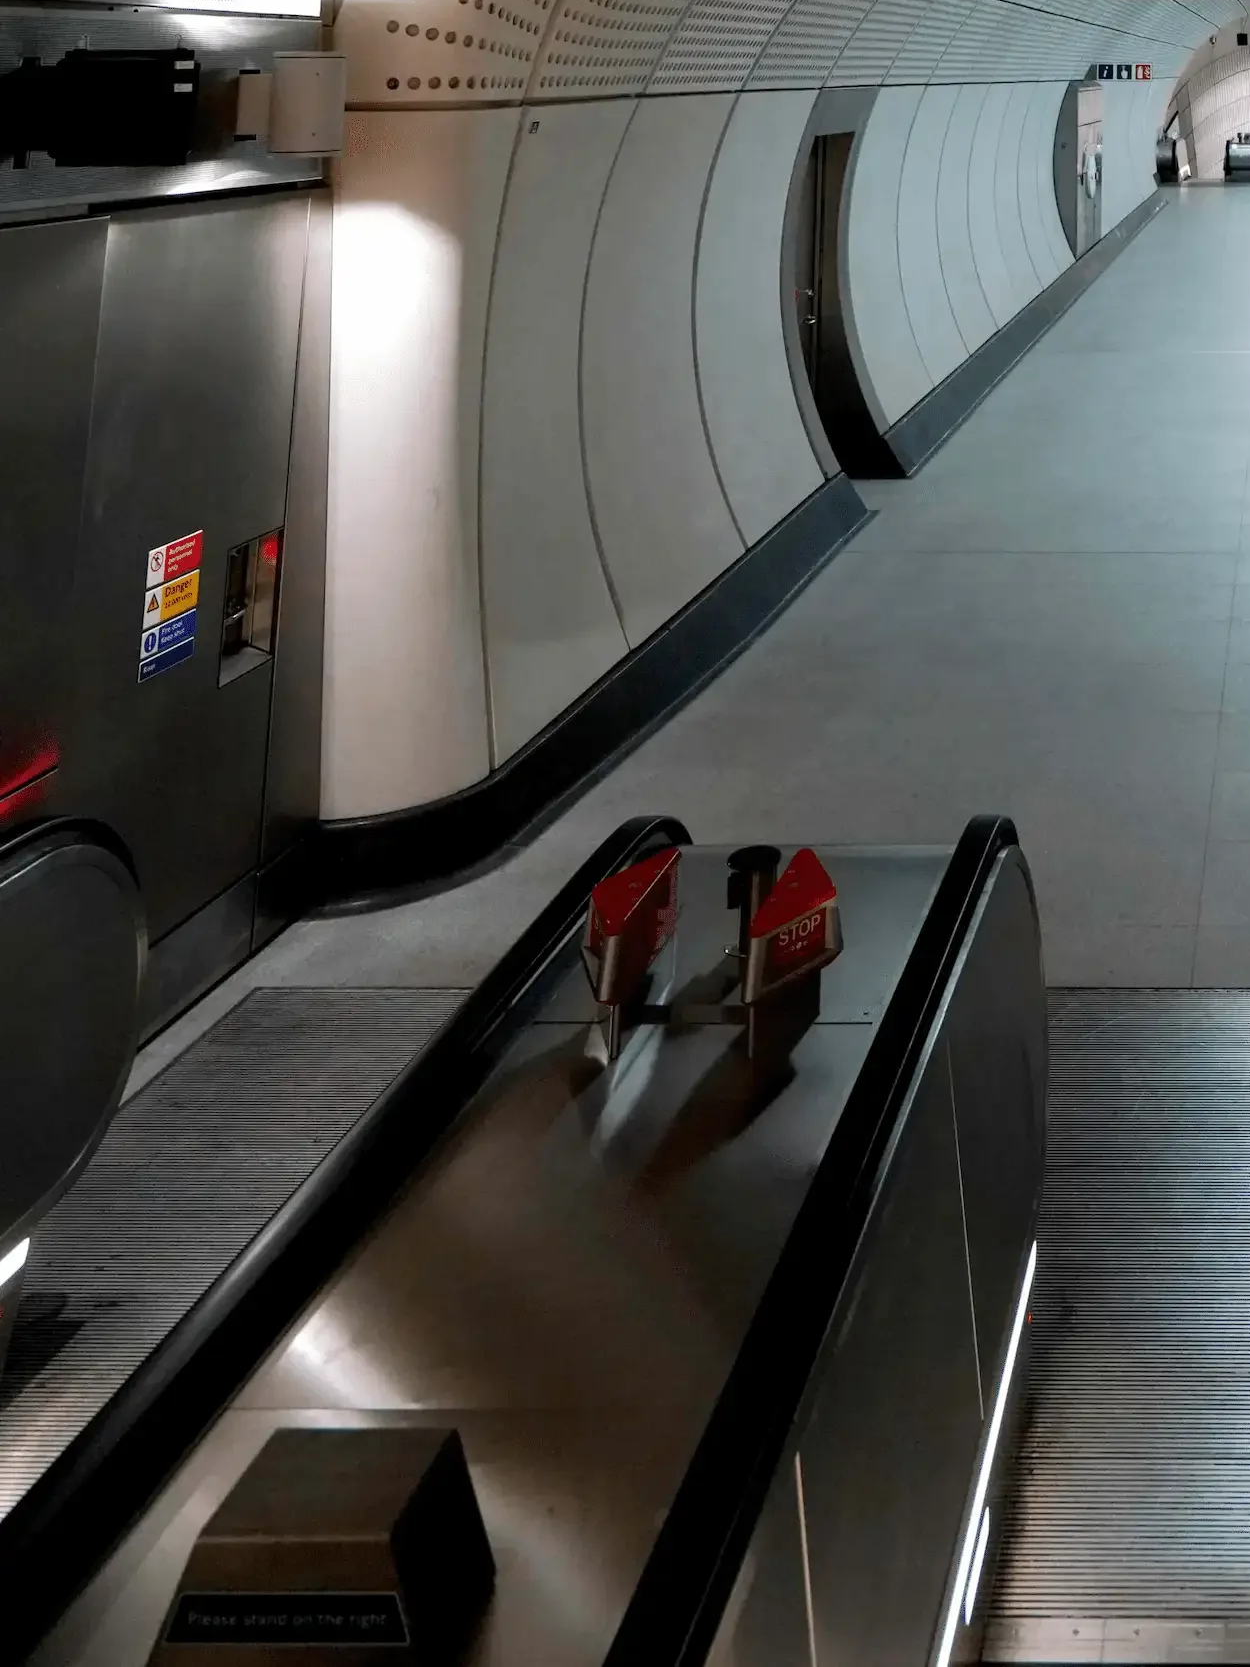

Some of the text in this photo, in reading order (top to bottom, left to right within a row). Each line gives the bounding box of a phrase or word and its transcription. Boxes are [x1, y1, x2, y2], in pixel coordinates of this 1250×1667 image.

[164, 579, 193, 598] Danger
[777, 914, 822, 947] STOP
[187, 1610, 239, 1627] Please
[242, 1612, 289, 1627] stand
[316, 1612, 344, 1627] the
[348, 1612, 389, 1630] right
